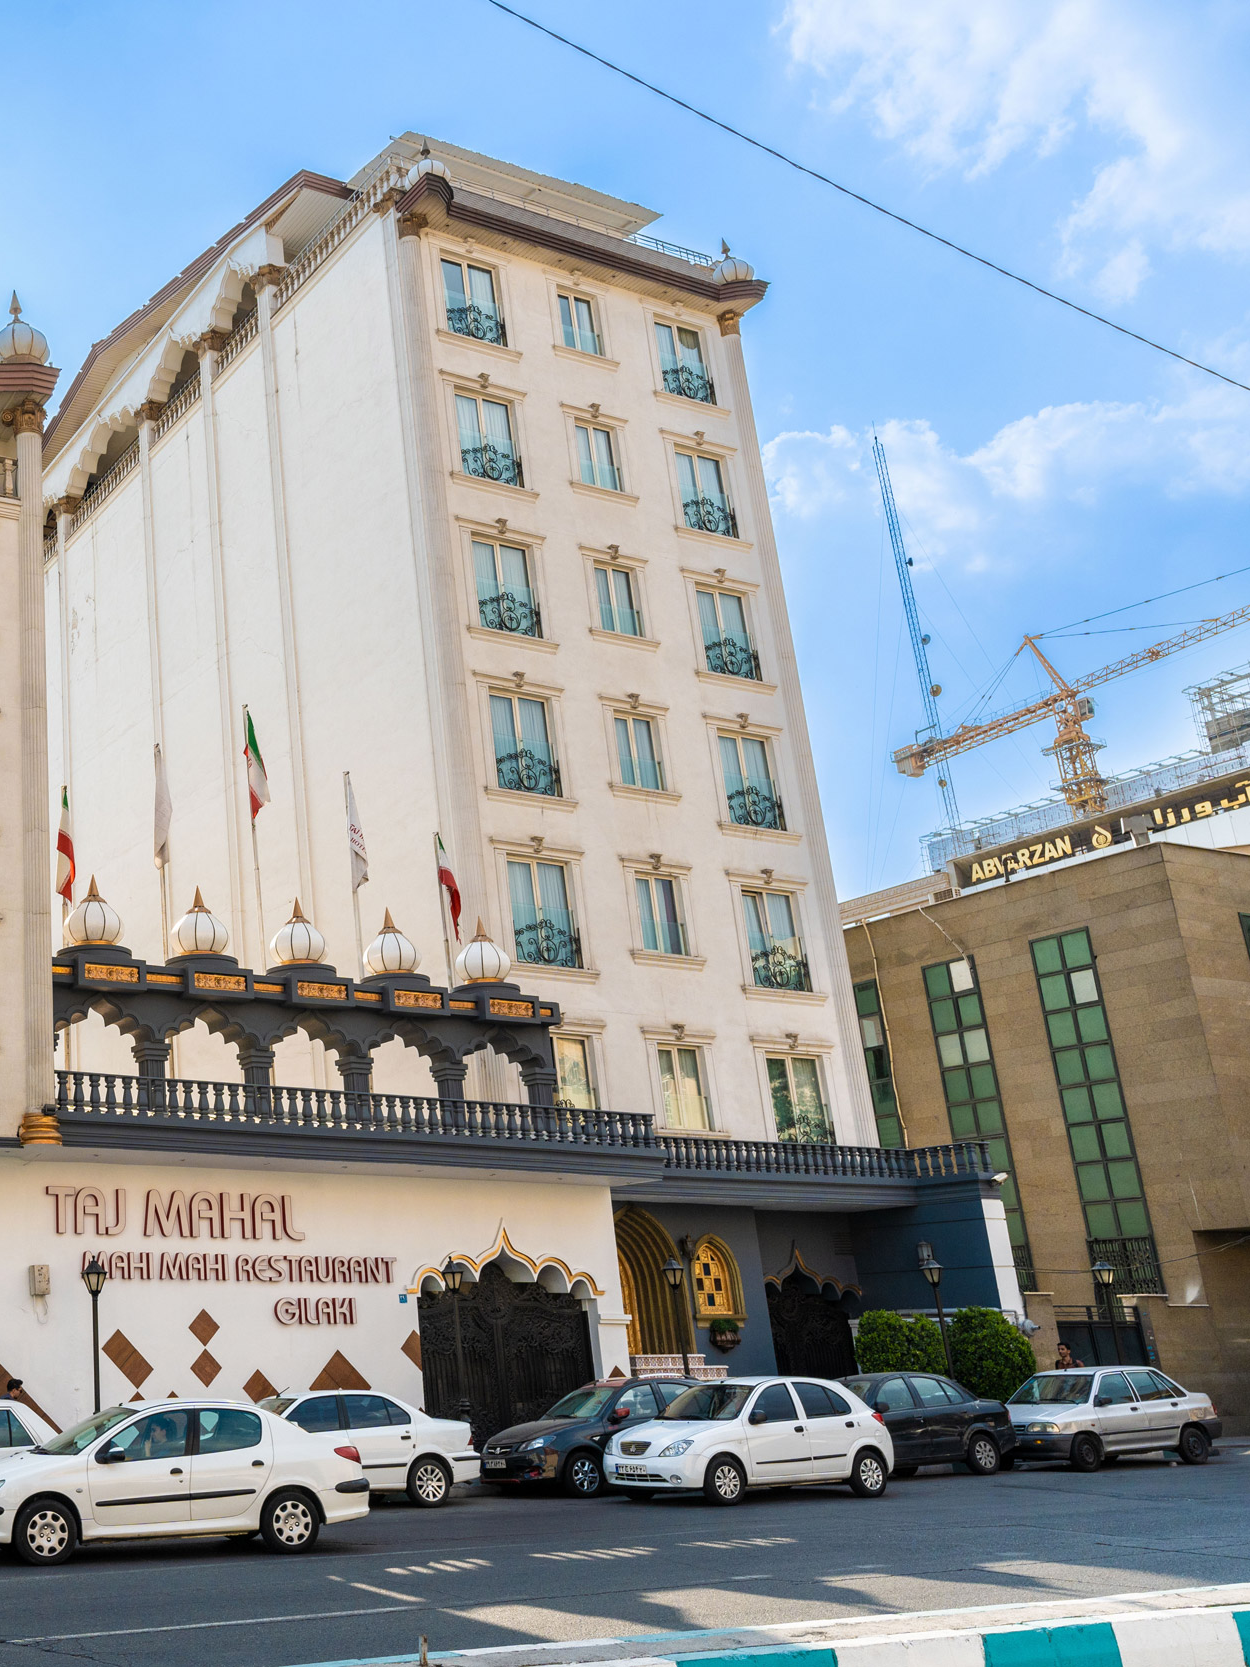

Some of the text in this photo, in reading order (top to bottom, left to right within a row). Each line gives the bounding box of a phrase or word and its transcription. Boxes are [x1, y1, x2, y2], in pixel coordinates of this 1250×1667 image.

[46, 1185, 306, 1242] TAJ MAHAL
[81, 1250, 398, 1284] MAHI MAHI RESTAURANT
[274, 1297, 358, 1326] GILAKI
